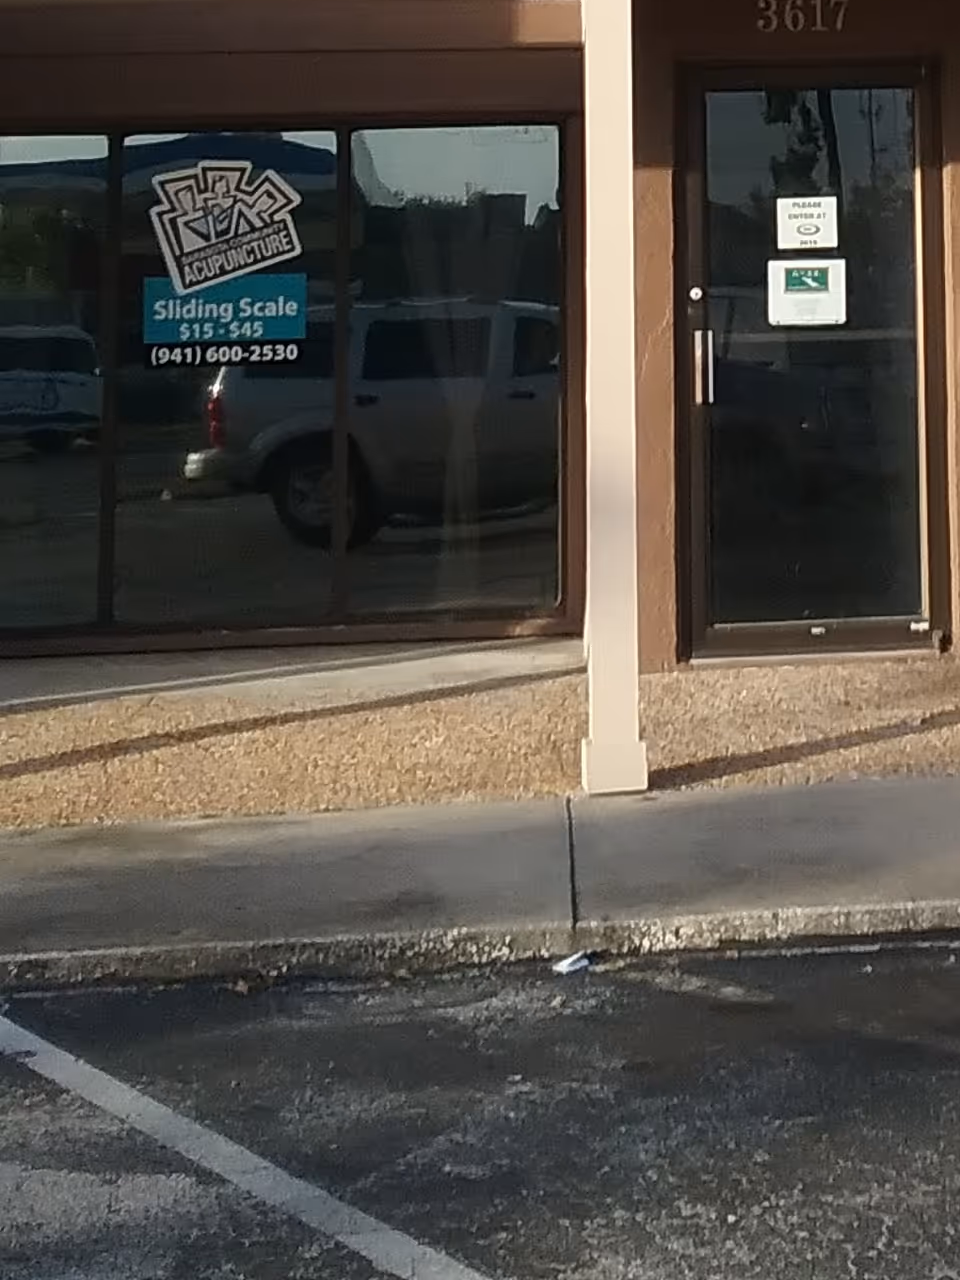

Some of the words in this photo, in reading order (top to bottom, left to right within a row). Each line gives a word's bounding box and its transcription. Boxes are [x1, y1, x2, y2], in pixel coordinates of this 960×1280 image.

[183, 229, 292, 286] ACUPUNCTURE
[153, 299, 233, 322] Sliding
[239, 296, 298, 317] Scale
[179, 323, 213, 341] $15
[230, 321, 264, 339] $45
[151, 345, 201, 365] (941)
[206, 343, 298, 362] 600-2530
